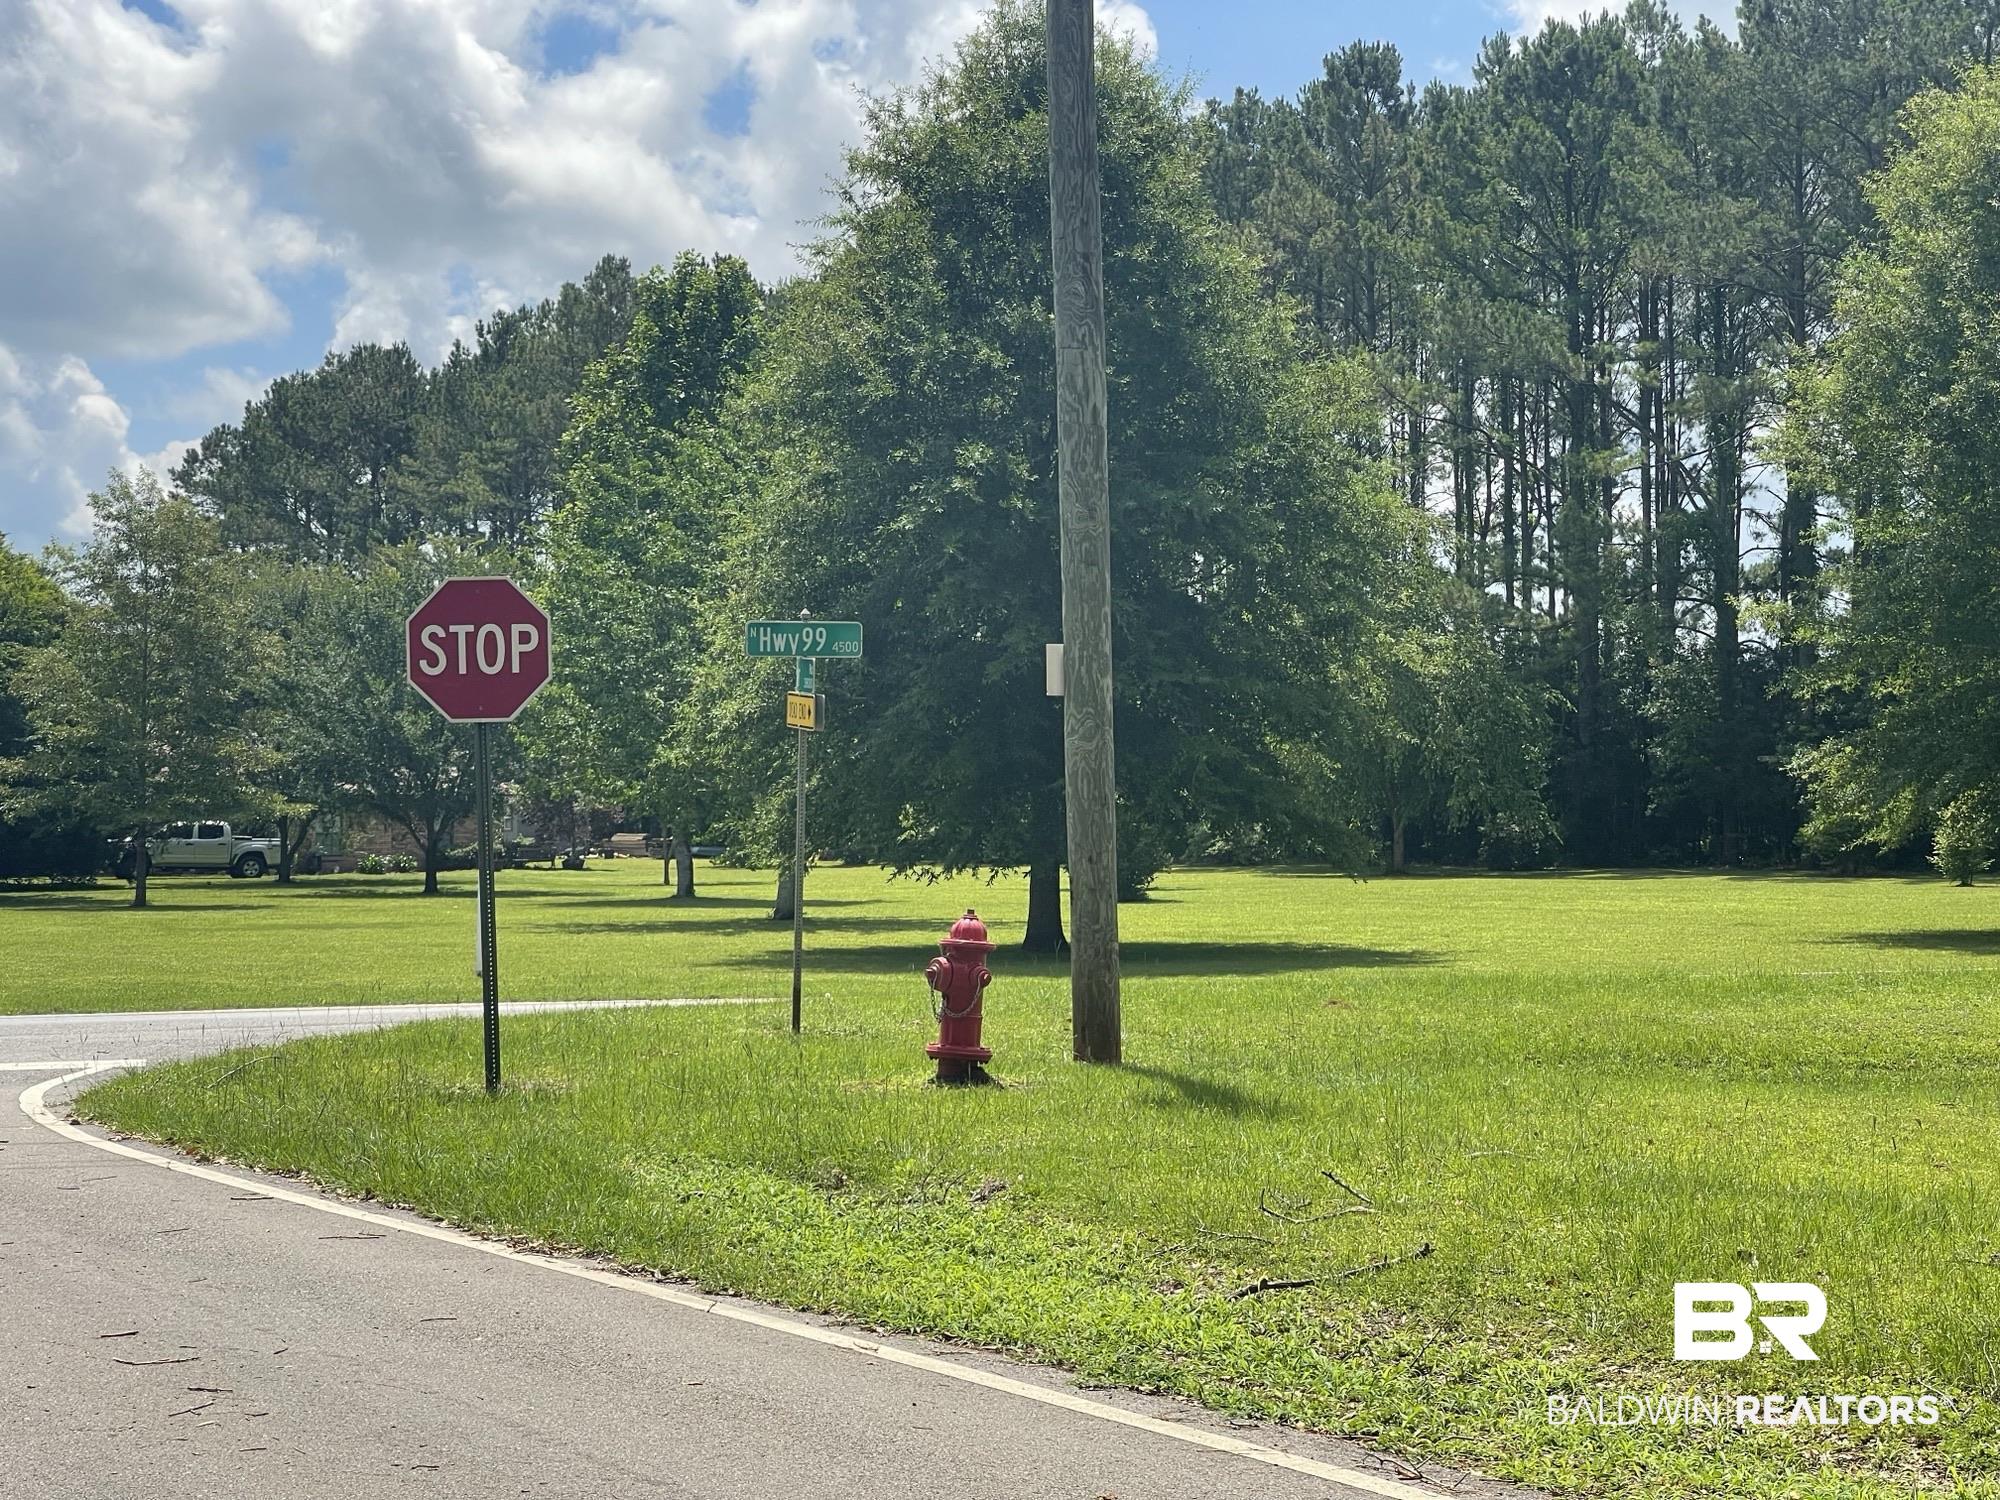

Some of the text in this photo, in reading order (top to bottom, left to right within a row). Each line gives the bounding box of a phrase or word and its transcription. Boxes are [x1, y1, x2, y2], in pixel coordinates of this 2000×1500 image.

[419, 623, 539, 676] STOP
[750, 627, 757, 638] N
[832, 641, 859, 653] 4500
